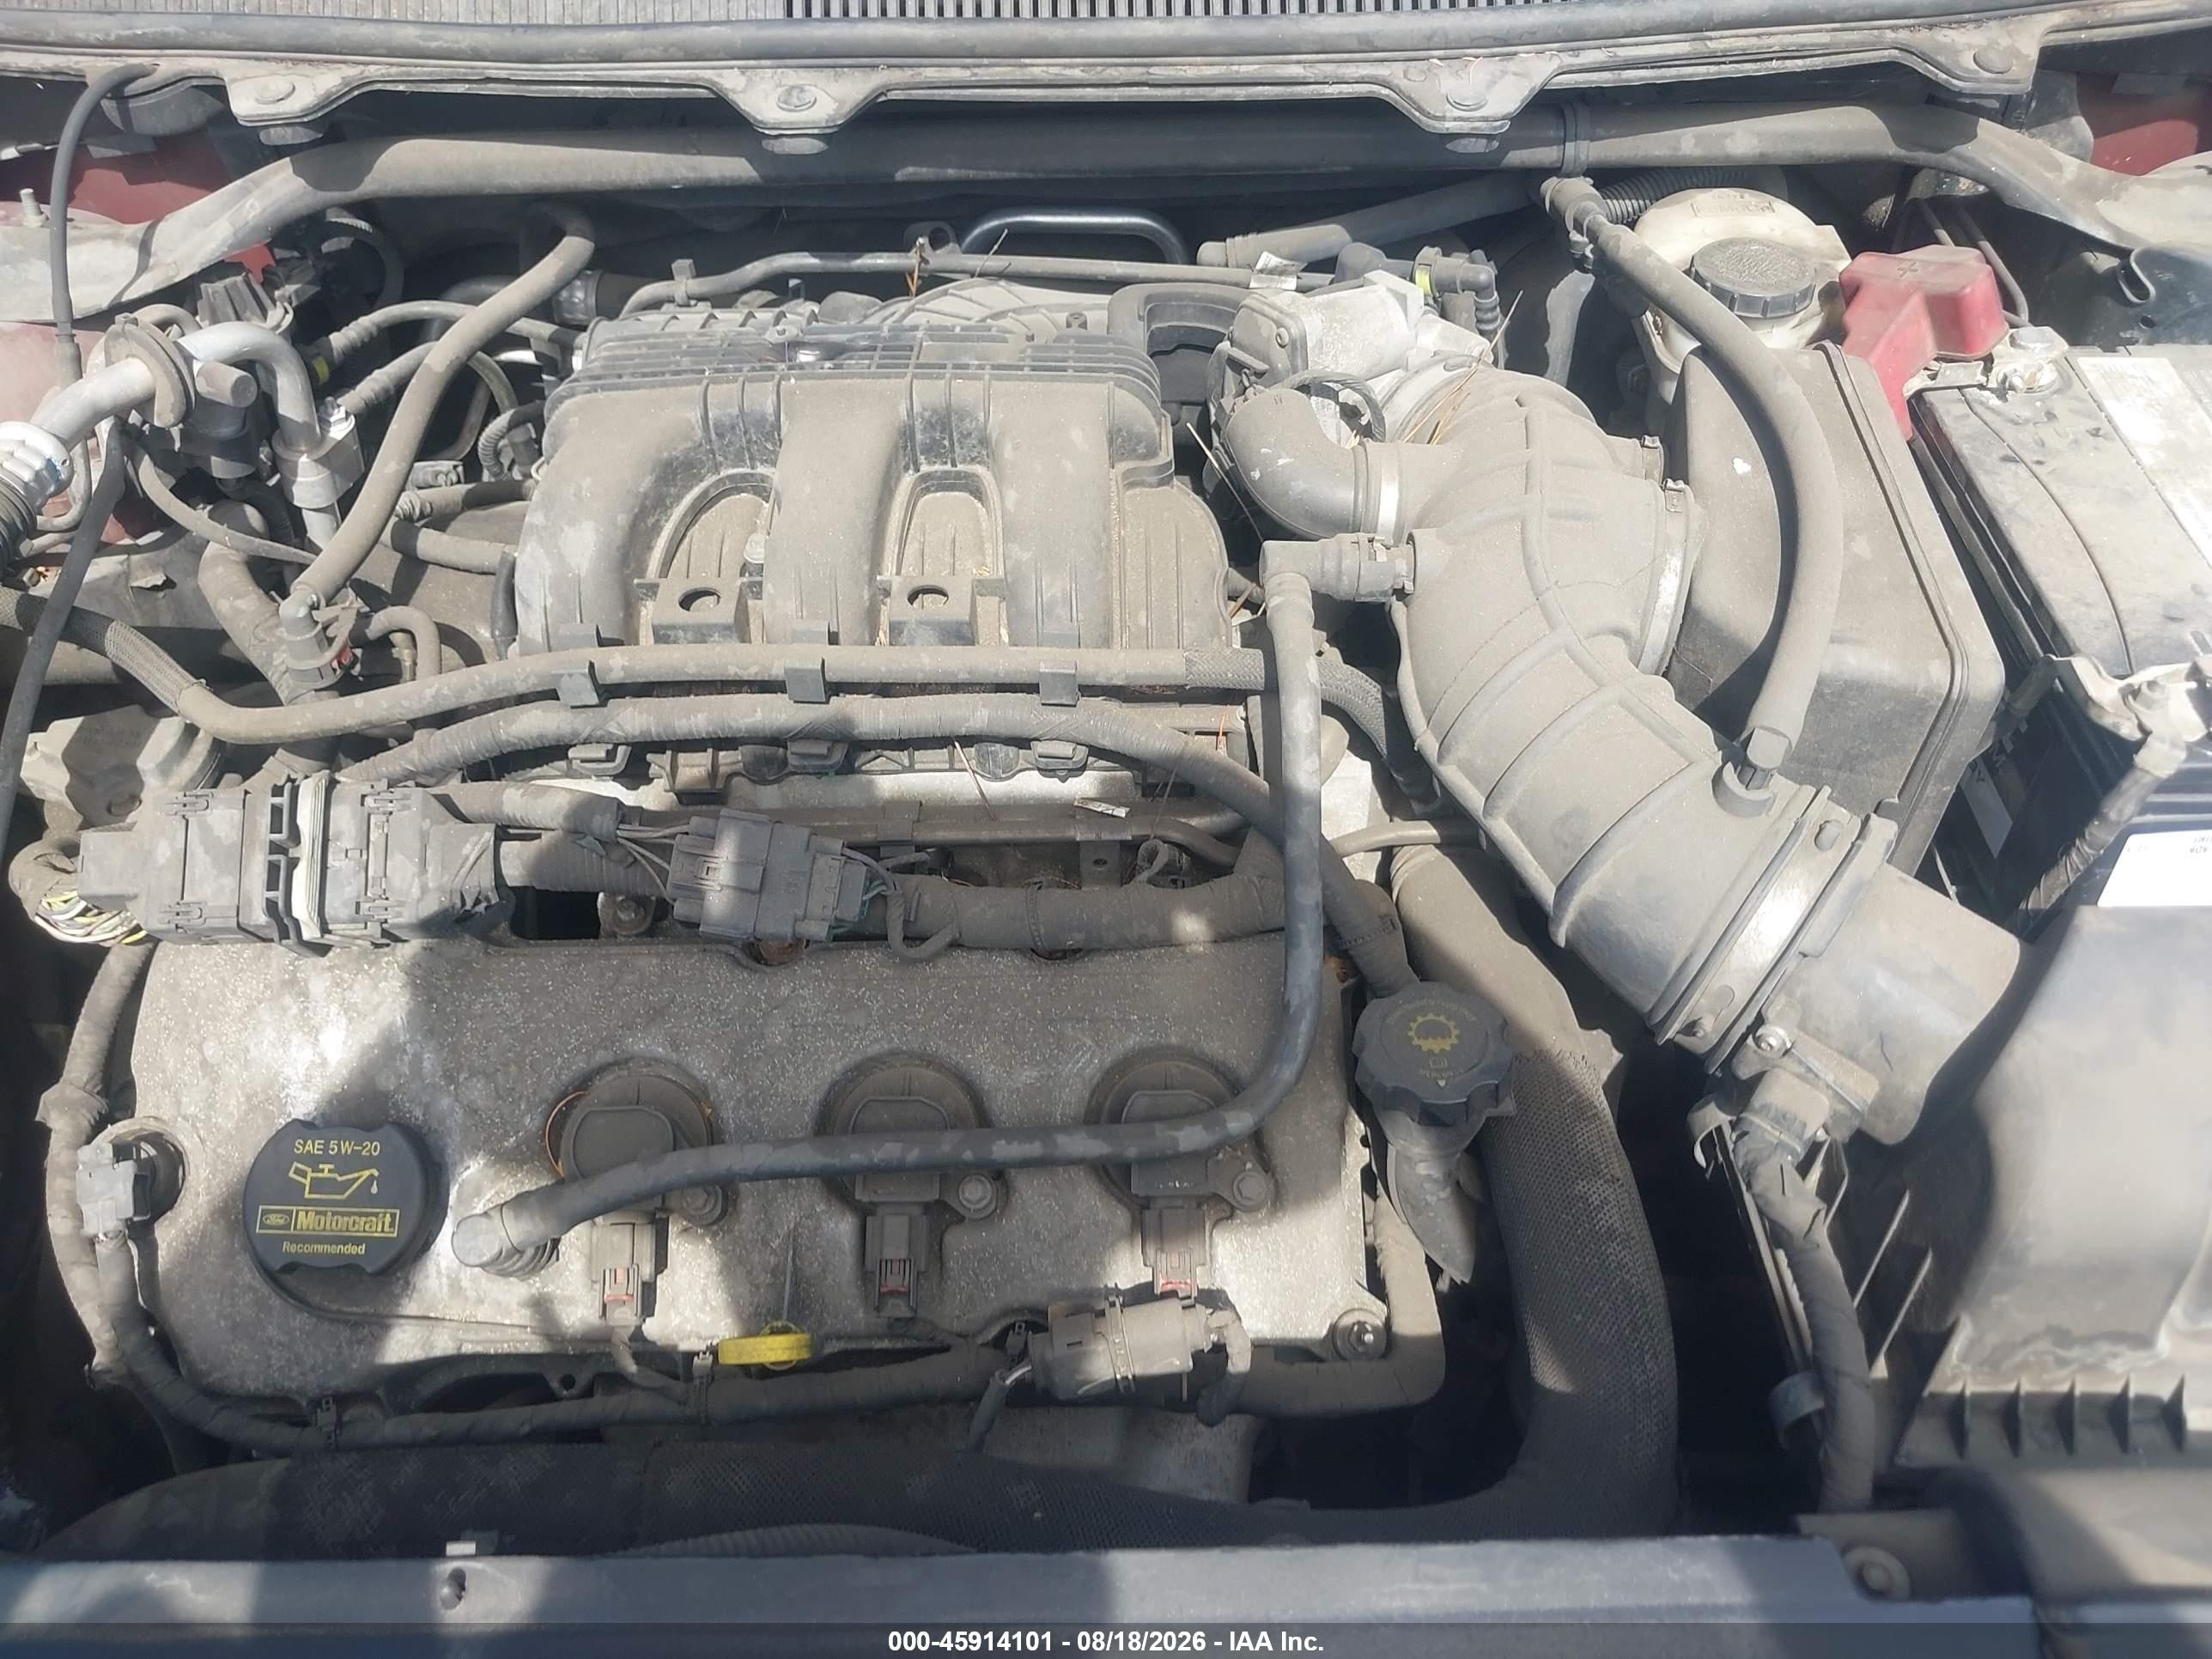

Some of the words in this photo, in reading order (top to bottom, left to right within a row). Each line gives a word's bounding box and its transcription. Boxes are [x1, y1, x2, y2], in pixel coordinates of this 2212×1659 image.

[294, 1139, 325, 1155] SAE
[328, 1140, 380, 1156] 5W-20
[296, 1211, 394, 1232] Motorcraft
[282, 1242, 366, 1255] Recommended
